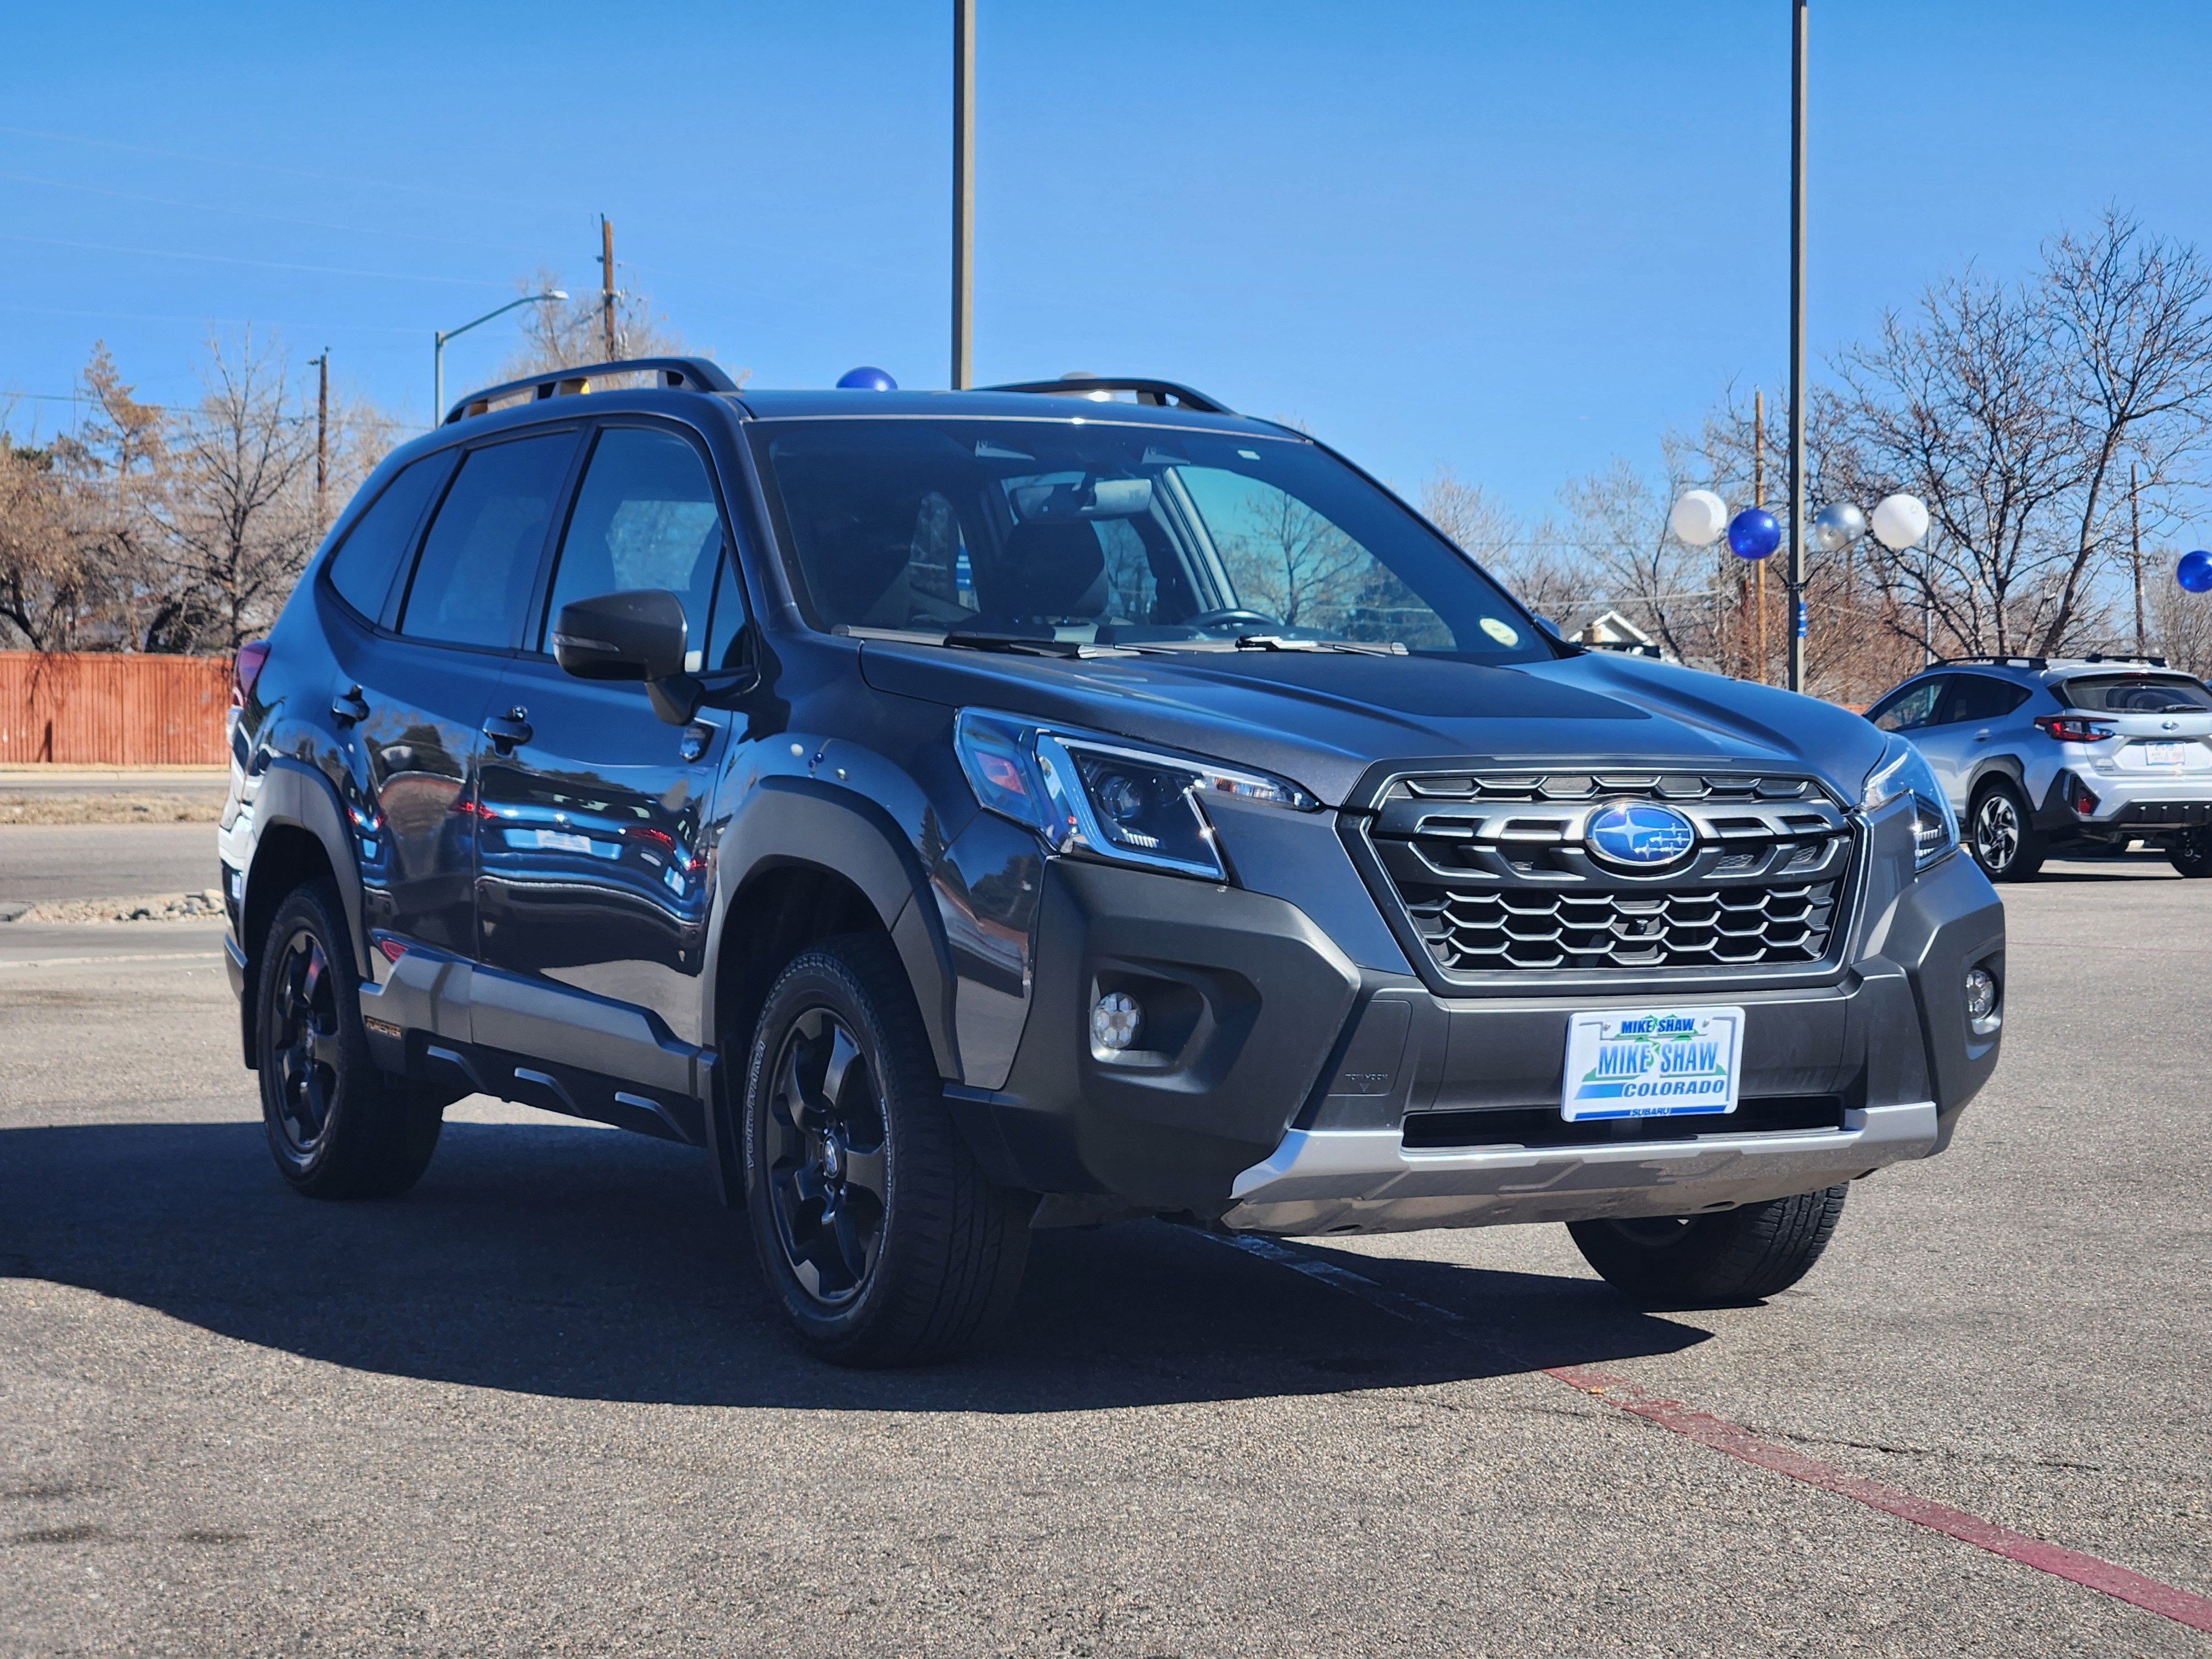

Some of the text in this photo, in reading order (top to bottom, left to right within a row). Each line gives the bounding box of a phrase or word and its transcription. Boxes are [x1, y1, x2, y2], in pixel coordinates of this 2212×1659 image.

[1621, 1018, 1695, 1034] MIKE SHAW
[1598, 1041, 1719, 1076] MIKE SHAW
[1623, 1079, 1725, 1098] COLORADO
[1631, 1107, 1670, 1117] SUBARU
